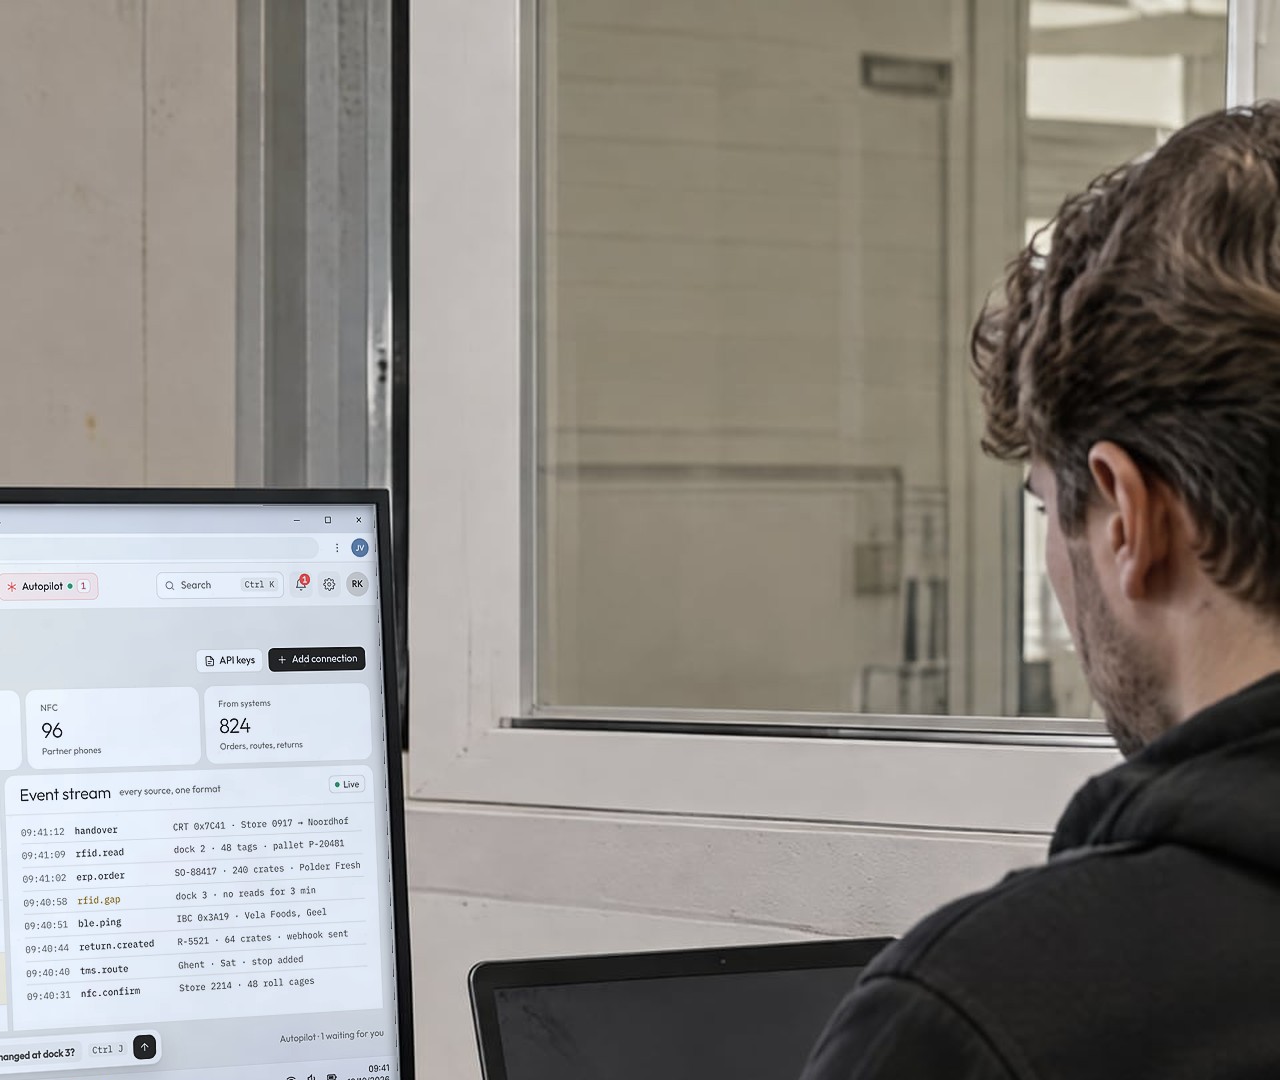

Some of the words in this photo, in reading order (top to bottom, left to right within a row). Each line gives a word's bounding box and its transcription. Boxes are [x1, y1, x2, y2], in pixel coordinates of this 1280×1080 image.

[356, 544, 364, 552] JV
[22, 581, 63, 592] Autopilot
[181, 581, 211, 589] Search
[352, 580, 363, 588] RK
[219, 656, 234, 664] API
[236, 656, 255, 666] keys
[292, 654, 309, 663] Add
[311, 654, 357, 663] connection
[218, 700, 239, 708] From
[240, 700, 271, 709] systems
[42, 722, 63, 738] 96
[220, 718, 251, 734] 824
[220, 742, 248, 751] Orders,
[250, 742, 275, 750] routes,
[277, 741, 303, 749] returns
[21, 788, 59, 802] Event
[63, 788, 111, 801] stream
[173, 822, 189, 831] CRT
[241, 820, 267, 829] Store
[272, 818, 292, 828] 0917
[308, 816, 348, 826] Noordhof
[21, 827, 64, 837] 09:41:12
[75, 826, 117, 835] handover
[76, 848, 124, 858] rfid.read
[233, 865, 248, 874] 240
[254, 865, 284, 874] crates
[300, 862, 330, 871] Polder
[335, 861, 360, 870] Fresh
[23, 873, 66, 884] 09:41:02
[76, 871, 125, 882] erp.order
[78, 896, 120, 906] rfid.gap
[78, 918, 122, 928] ble.ping
[80, 939, 154, 951] return.created
[80, 965, 128, 975] tms.route
[179, 984, 206, 992] Store
[211, 981, 232, 990] 2214
[247, 980, 258, 988] 48
[264, 978, 283, 987] roll
[289, 978, 314, 987] cages
[27, 990, 71, 1001] 09:40:31
[81, 986, 140, 998] nfc.confirm
[32, 1050, 41, 1059] at
[43, 1049, 64, 1058] dock
[65, 1048, 75, 1057] 3?
[369, 1064, 389, 1073] 09:41
